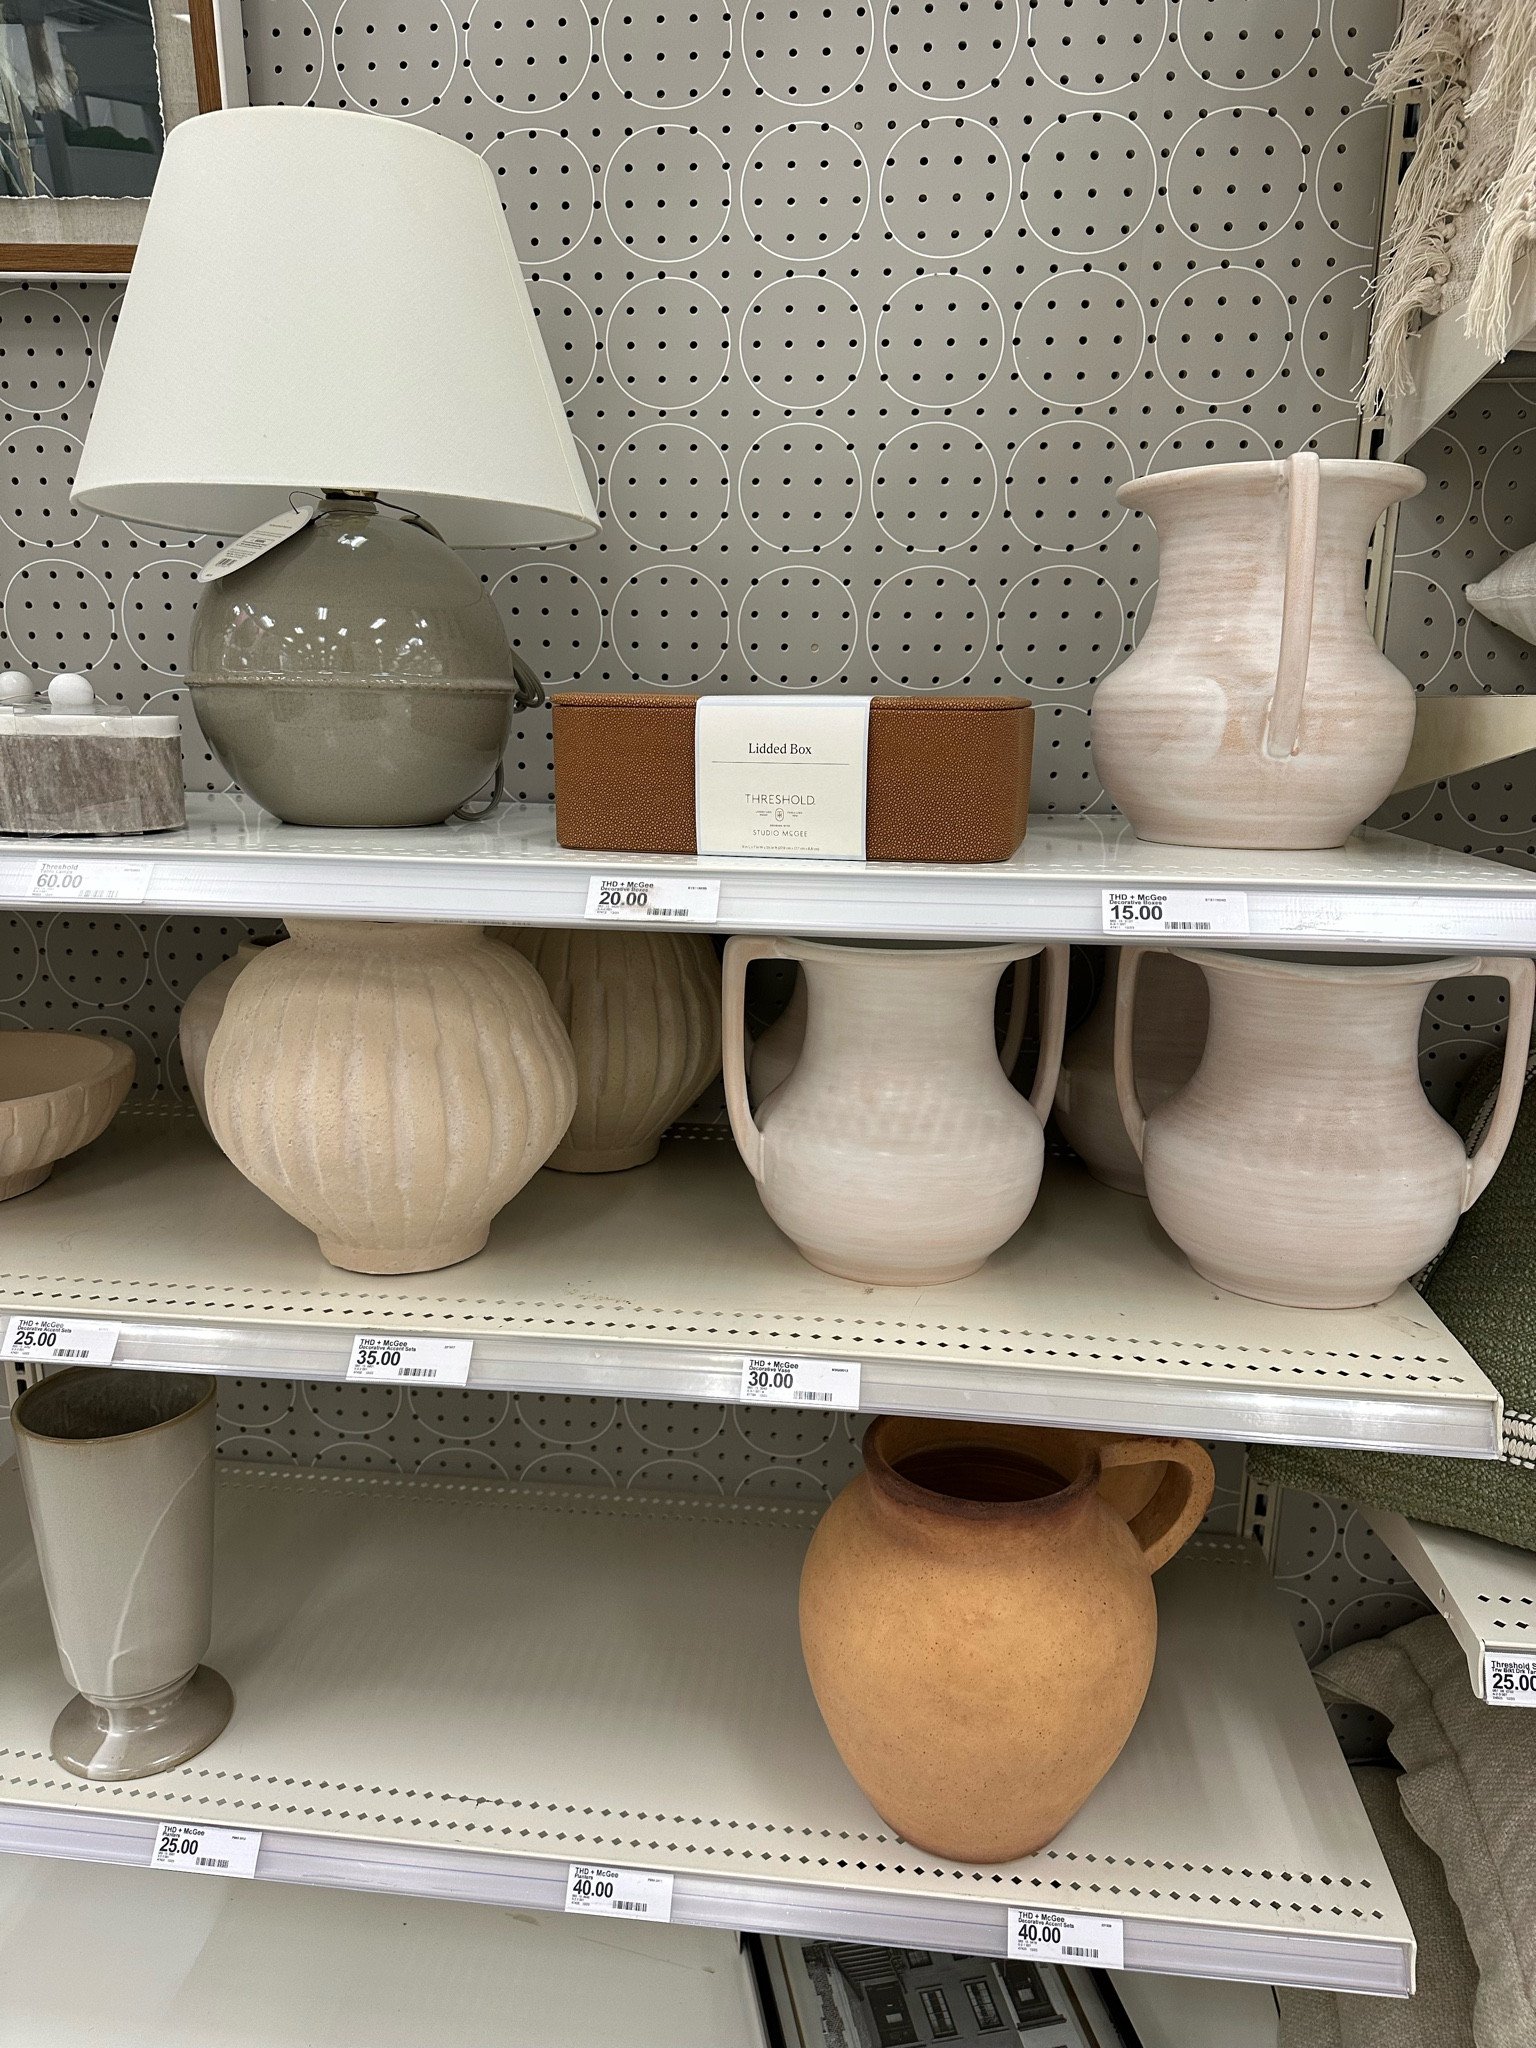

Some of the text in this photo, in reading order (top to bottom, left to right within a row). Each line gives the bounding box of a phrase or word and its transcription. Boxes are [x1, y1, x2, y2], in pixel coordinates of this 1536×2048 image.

[748, 742, 812, 754] Lidded Box
[36, 874, 82, 888] 60.00
[599, 891, 648, 906] 20.00
[1110, 905, 1162, 920] 15.00
[14, 1331, 56, 1346] 25.00
[356, 1350, 400, 1366] 35.00
[774, 1361, 798, 1369] McGee
[748, 1371, 794, 1388] 30.00
[1491, 1660, 1530, 1670] Threshold
[184, 1828, 205, 1836] McGee
[160, 1837, 198, 1855] 25.00
[596, 1869, 618, 1878] McGee
[573, 1879, 614, 1898] 40.00
[1018, 1911, 1034, 1919] THD
[1041, 1914, 1064, 1922] McGee
[1018, 1918, 1044, 1926] Decorative
[1018, 1924, 1061, 1944] 40.00
